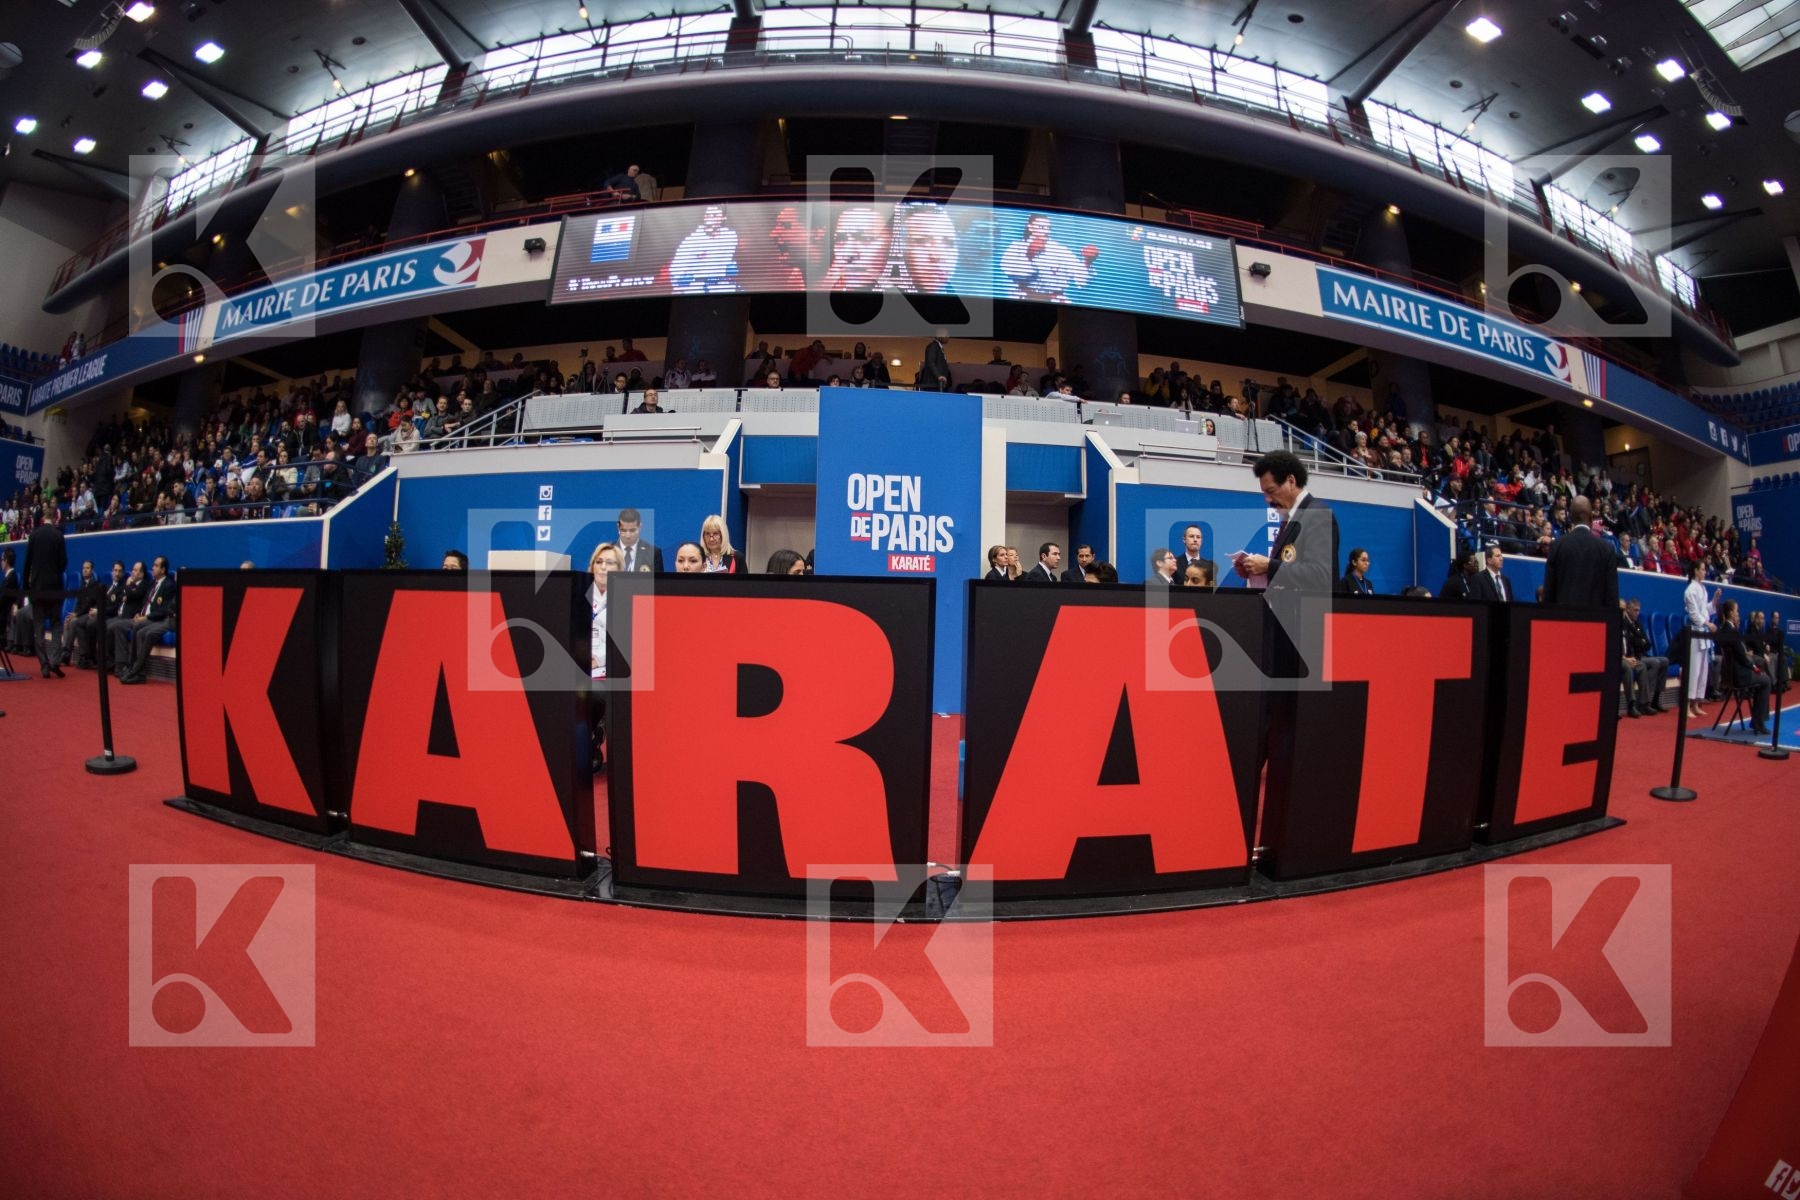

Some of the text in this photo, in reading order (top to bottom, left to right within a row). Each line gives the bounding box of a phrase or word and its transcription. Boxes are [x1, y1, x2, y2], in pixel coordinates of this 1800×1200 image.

[1143, 246, 1195, 273] OPEN
[222, 258, 419, 330] MAIRIE DE PARIS
[1333, 281, 1536, 361] MAIRIE DE PARIS
[51, 367, 80, 397] PREMIER
[78, 354, 108, 384] LEAGUE
[847, 473, 921, 512] OPEN
[1736, 504, 1755, 520] OPEN
[850, 513, 954, 553] DE PARIS
[1743, 516, 1763, 532] PARIS
[891, 555, 931, 571] KARATÉ
[180, 587, 1608, 883] KARATE
